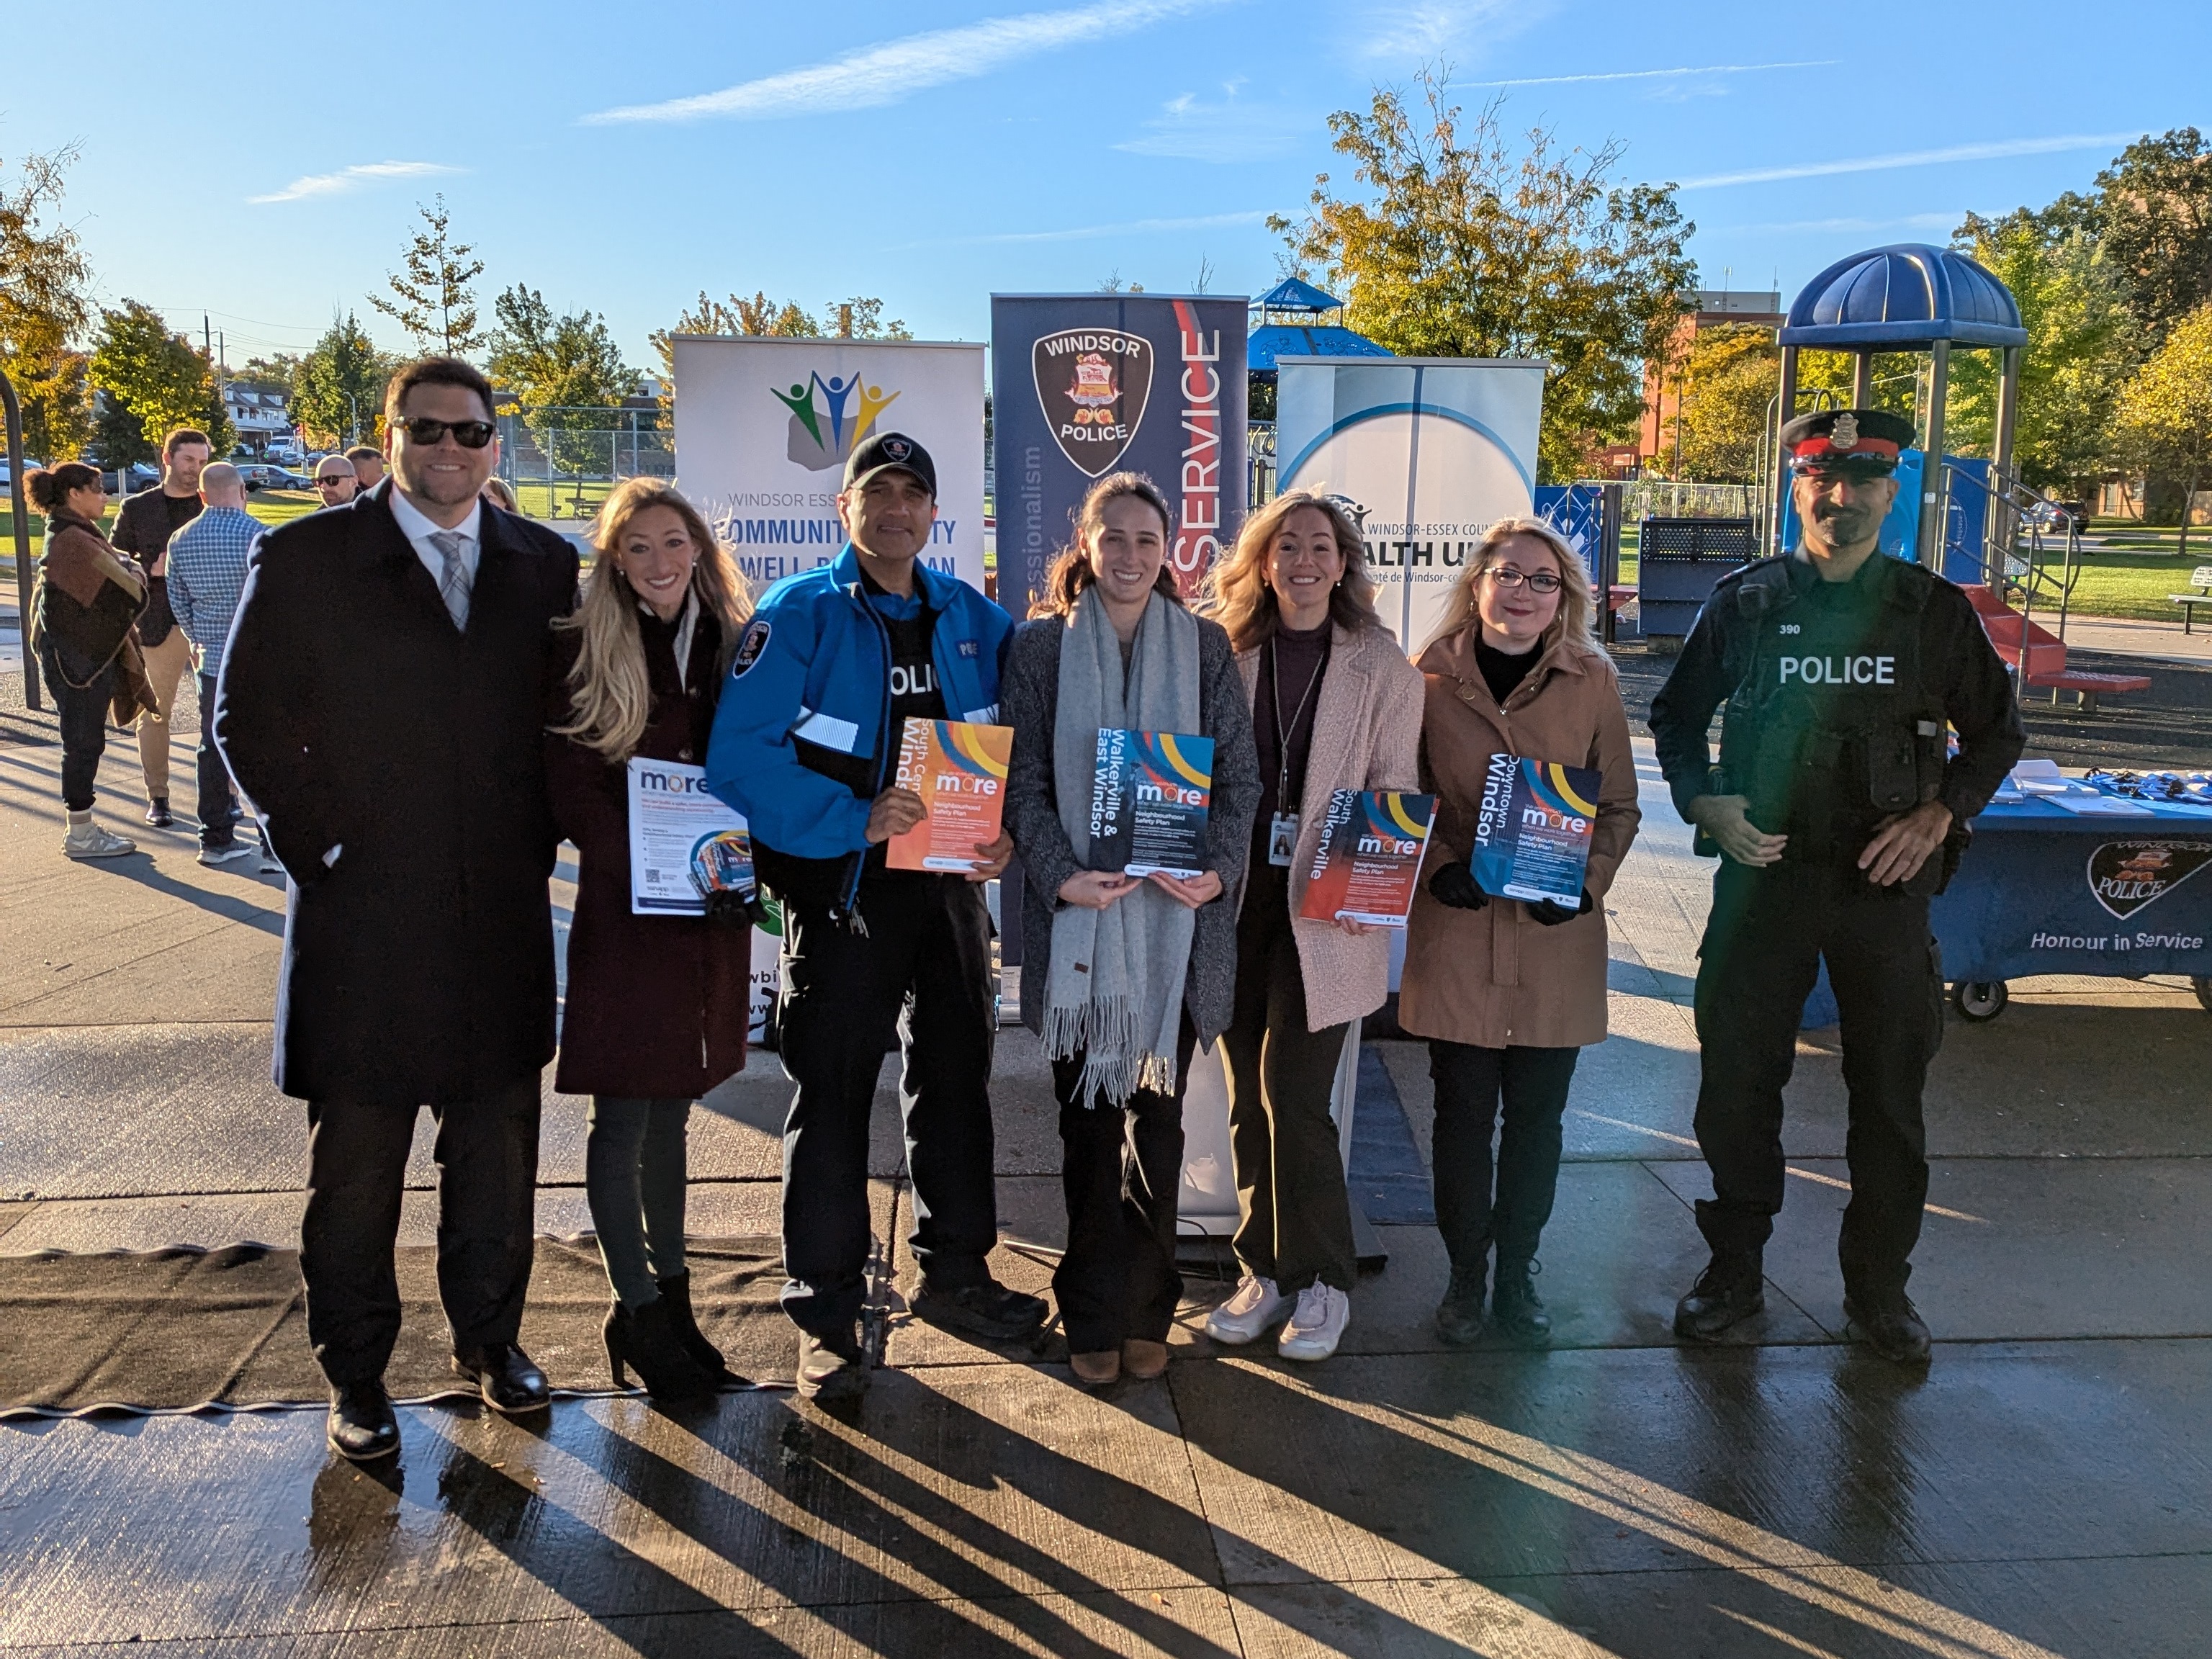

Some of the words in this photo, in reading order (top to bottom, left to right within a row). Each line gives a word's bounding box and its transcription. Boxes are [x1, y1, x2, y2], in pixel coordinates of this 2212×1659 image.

[1045, 335, 1141, 358] WINDSOR
[1061, 423, 1128, 441] POLICE
[1174, 329, 1220, 572] SERVICE
[728, 493, 804, 507] WINDSOR
[1368, 523, 1458, 536] WINDSOR-ESSEX
[1390, 571, 1402, 582] de
[1779, 624, 1801, 634] 390
[1779, 656, 1895, 684] POLICE
[914, 718, 934, 760] South
[1097, 727, 1112, 763] East
[641, 770, 709, 793] more
[936, 774, 997, 796] more
[1105, 729, 1125, 821] Walkerville
[1090, 767, 1110, 839] Windsor
[1137, 784, 1202, 806] more
[1475, 753, 1509, 848] Windsor
[1496, 755, 1521, 829] Downtown
[1339, 788, 1358, 825] South
[1104, 824, 1118, 837] &
[1521, 808, 1586, 833] more
[1310, 788, 1346, 880] Walkerville
[1357, 837, 1416, 855] more
[2096, 876, 2167, 899] POLICE
[2030, 932, 2108, 950] Honour
[2113, 933, 2131, 950] in
[2135, 932, 2203, 949] Service
